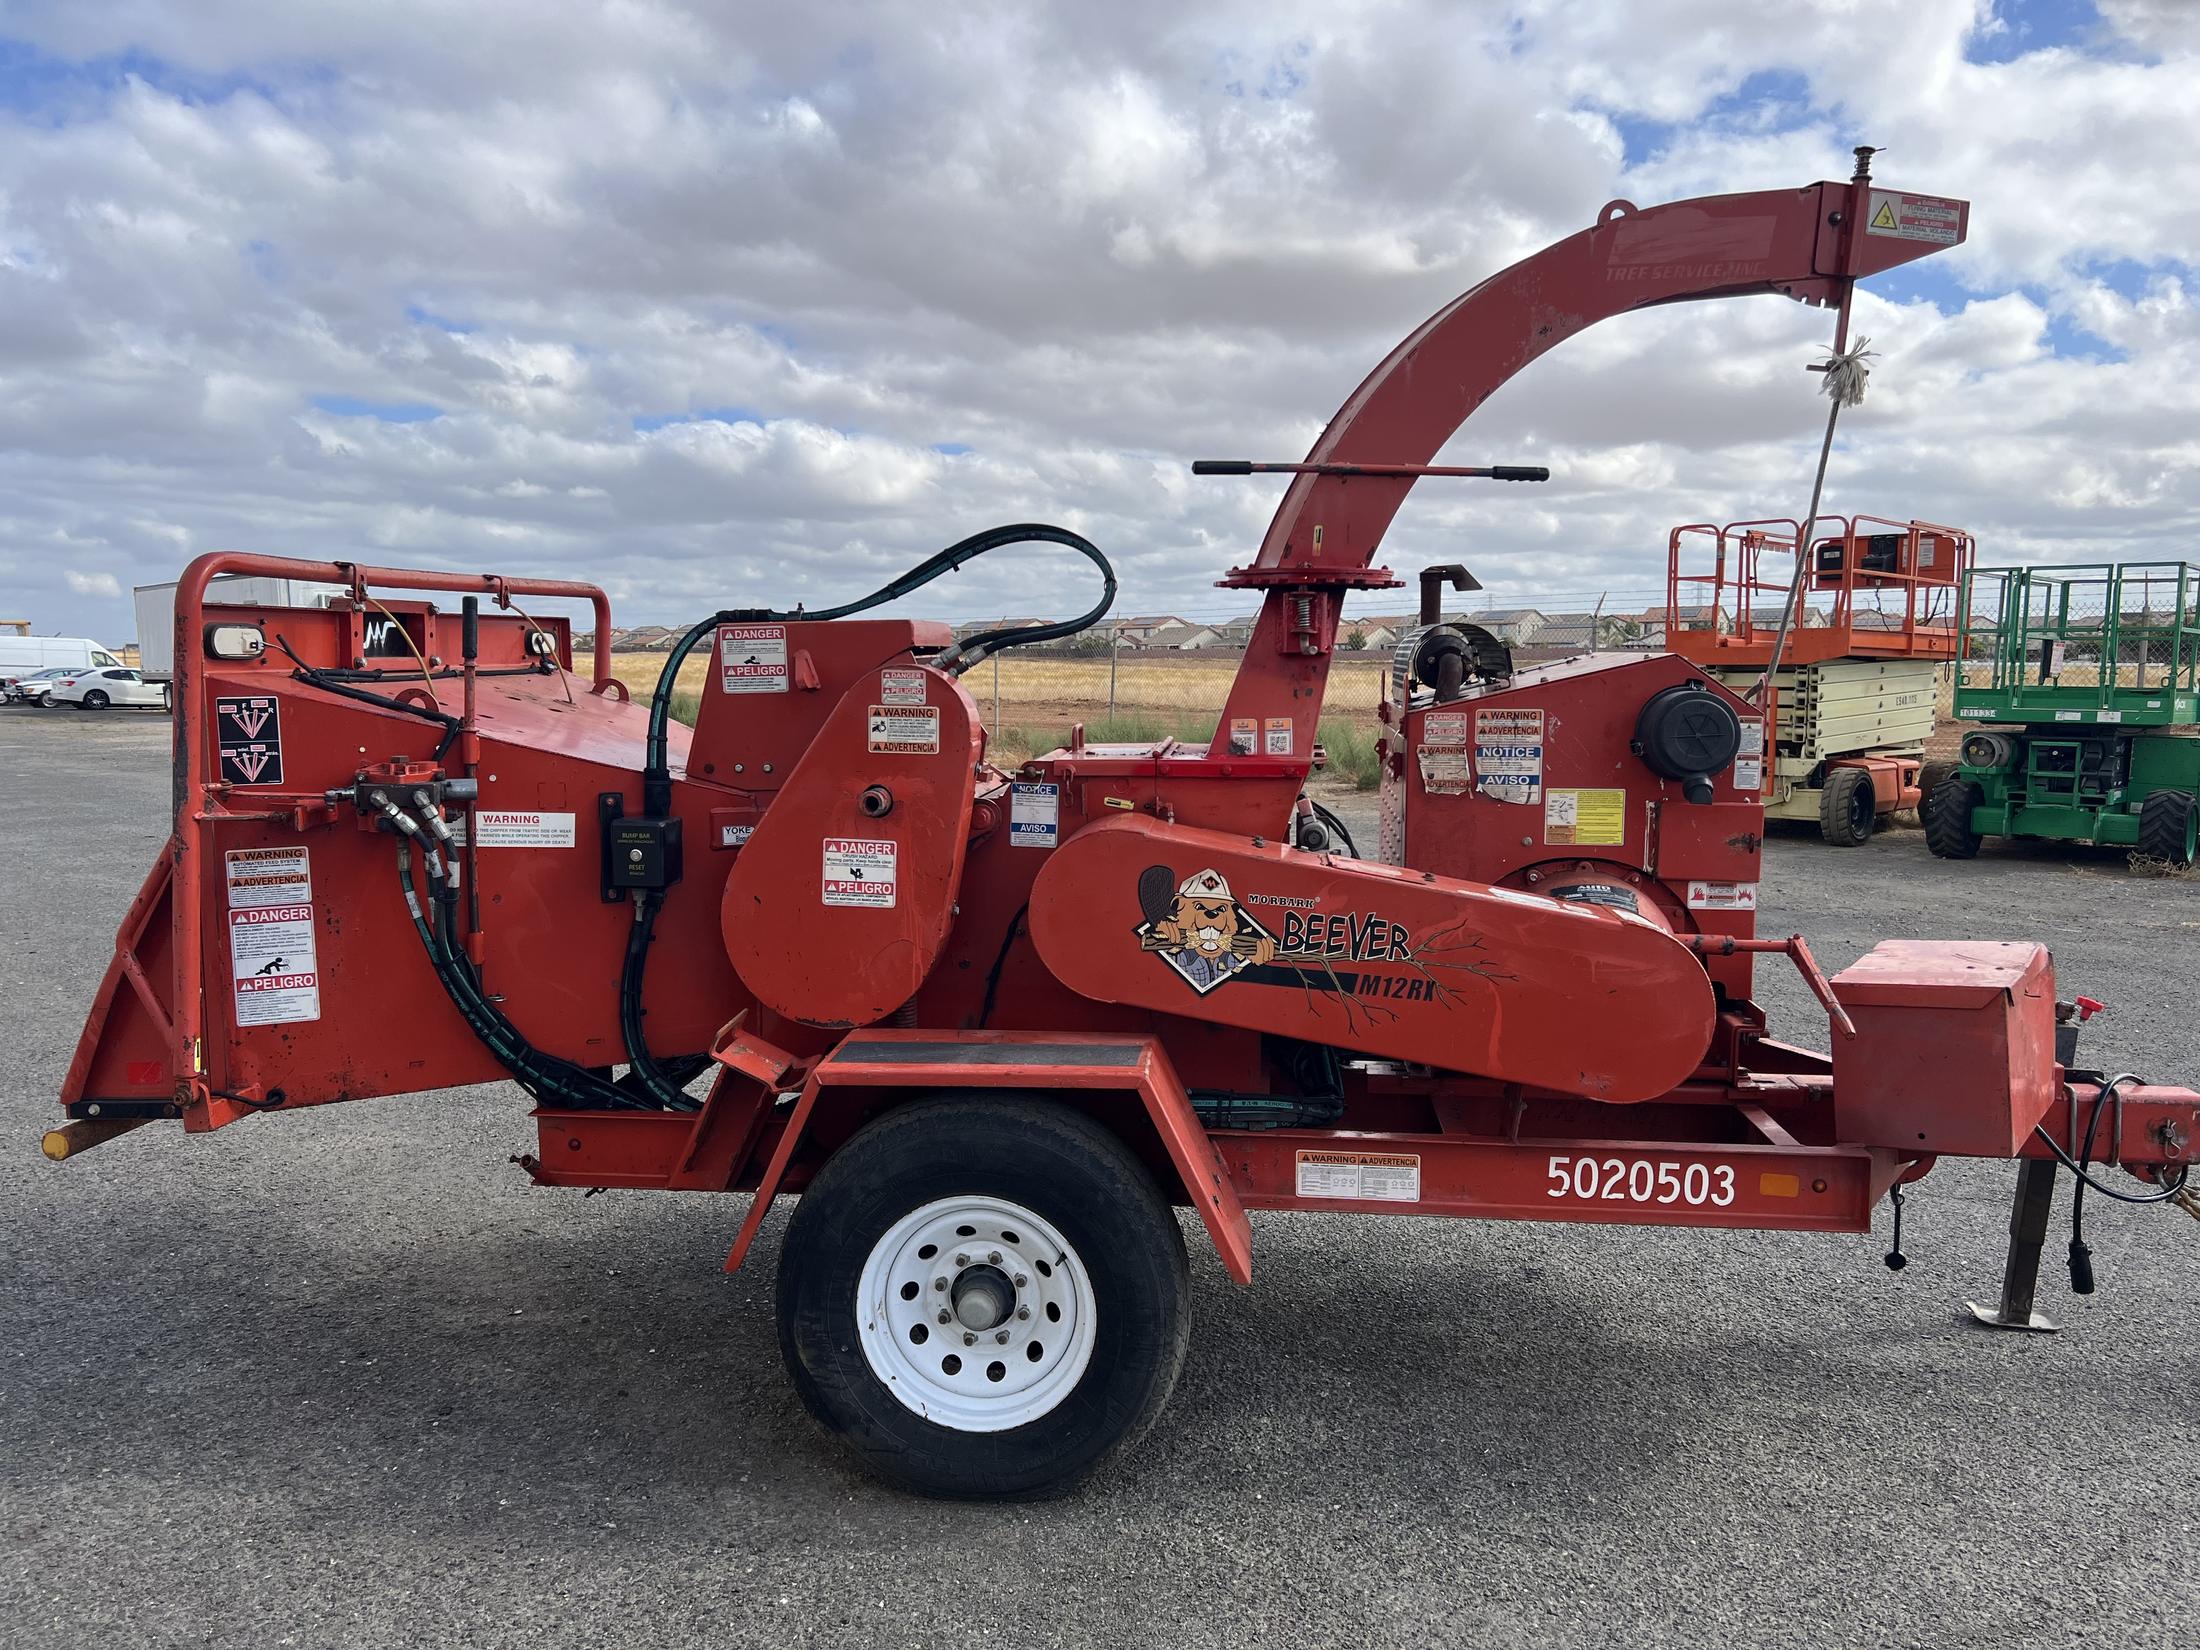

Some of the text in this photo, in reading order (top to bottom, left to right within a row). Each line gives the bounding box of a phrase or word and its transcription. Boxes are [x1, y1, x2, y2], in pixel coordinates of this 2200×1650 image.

[1902, 224, 1955, 236] MATERIAL VOLANDO
[1606, 266, 1649, 281] TREE
[734, 629, 781, 639] DANGER
[736, 665, 785, 676] PELIGRO
[883, 708, 934, 718] WARNING
[1490, 711, 1537, 720] WARNING
[1487, 726, 1539, 735] ADVERTENCIA
[883, 743, 935, 752] ADVERTENCIA
[1482, 747, 1535, 757] NOTICE
[1485, 775, 1530, 785] AVISO
[483, 815, 540, 824] WARNING
[725, 826, 751, 834] YOKE
[1020, 824, 1047, 833] AVISO
[840, 842, 891, 855] DANGER
[244, 849, 303, 860] WARNING
[243, 875, 306, 887] ADVERTENCIA
[838, 882, 892, 894] PELIGRO
[1248, 893, 1315, 909] MORBARK
[249, 908, 309, 923] DANGER
[1280, 910, 1412, 962] BEEVER
[254, 975, 314, 991] PELIGRO
[1358, 974, 1438, 1001] M12RX
[1311, 1154, 1357, 1164] WARNING
[1368, 1157, 1417, 1166] ADVERTENCIA
[1547, 1156, 1735, 1206] 5020503
